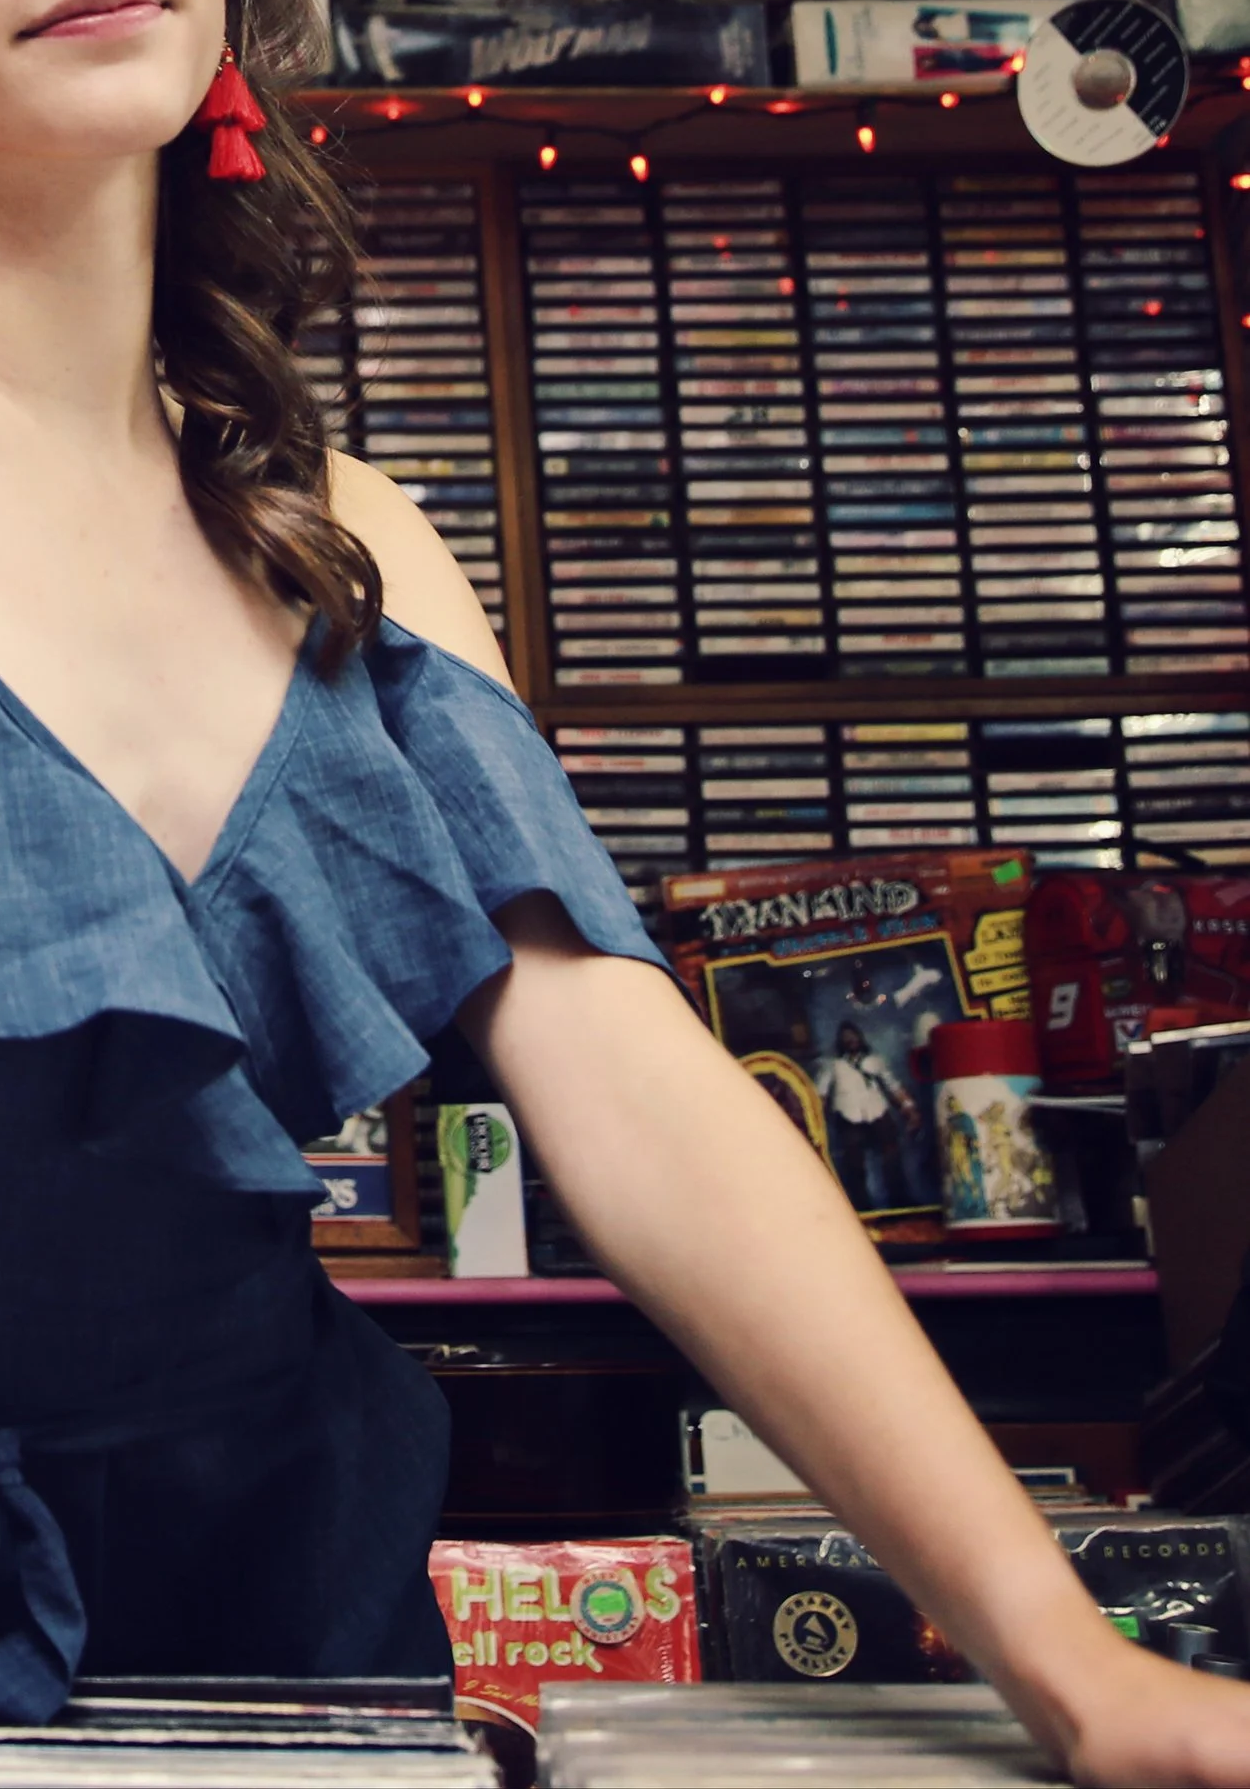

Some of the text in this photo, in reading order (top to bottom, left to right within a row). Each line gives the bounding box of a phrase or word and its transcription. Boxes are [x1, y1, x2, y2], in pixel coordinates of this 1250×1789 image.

[699, 873, 920, 941] MANKIND
[1103, 1541, 1226, 1559] RECORDS
[451, 1563, 682, 1622] HELS
[505, 1632, 603, 1673] rock
